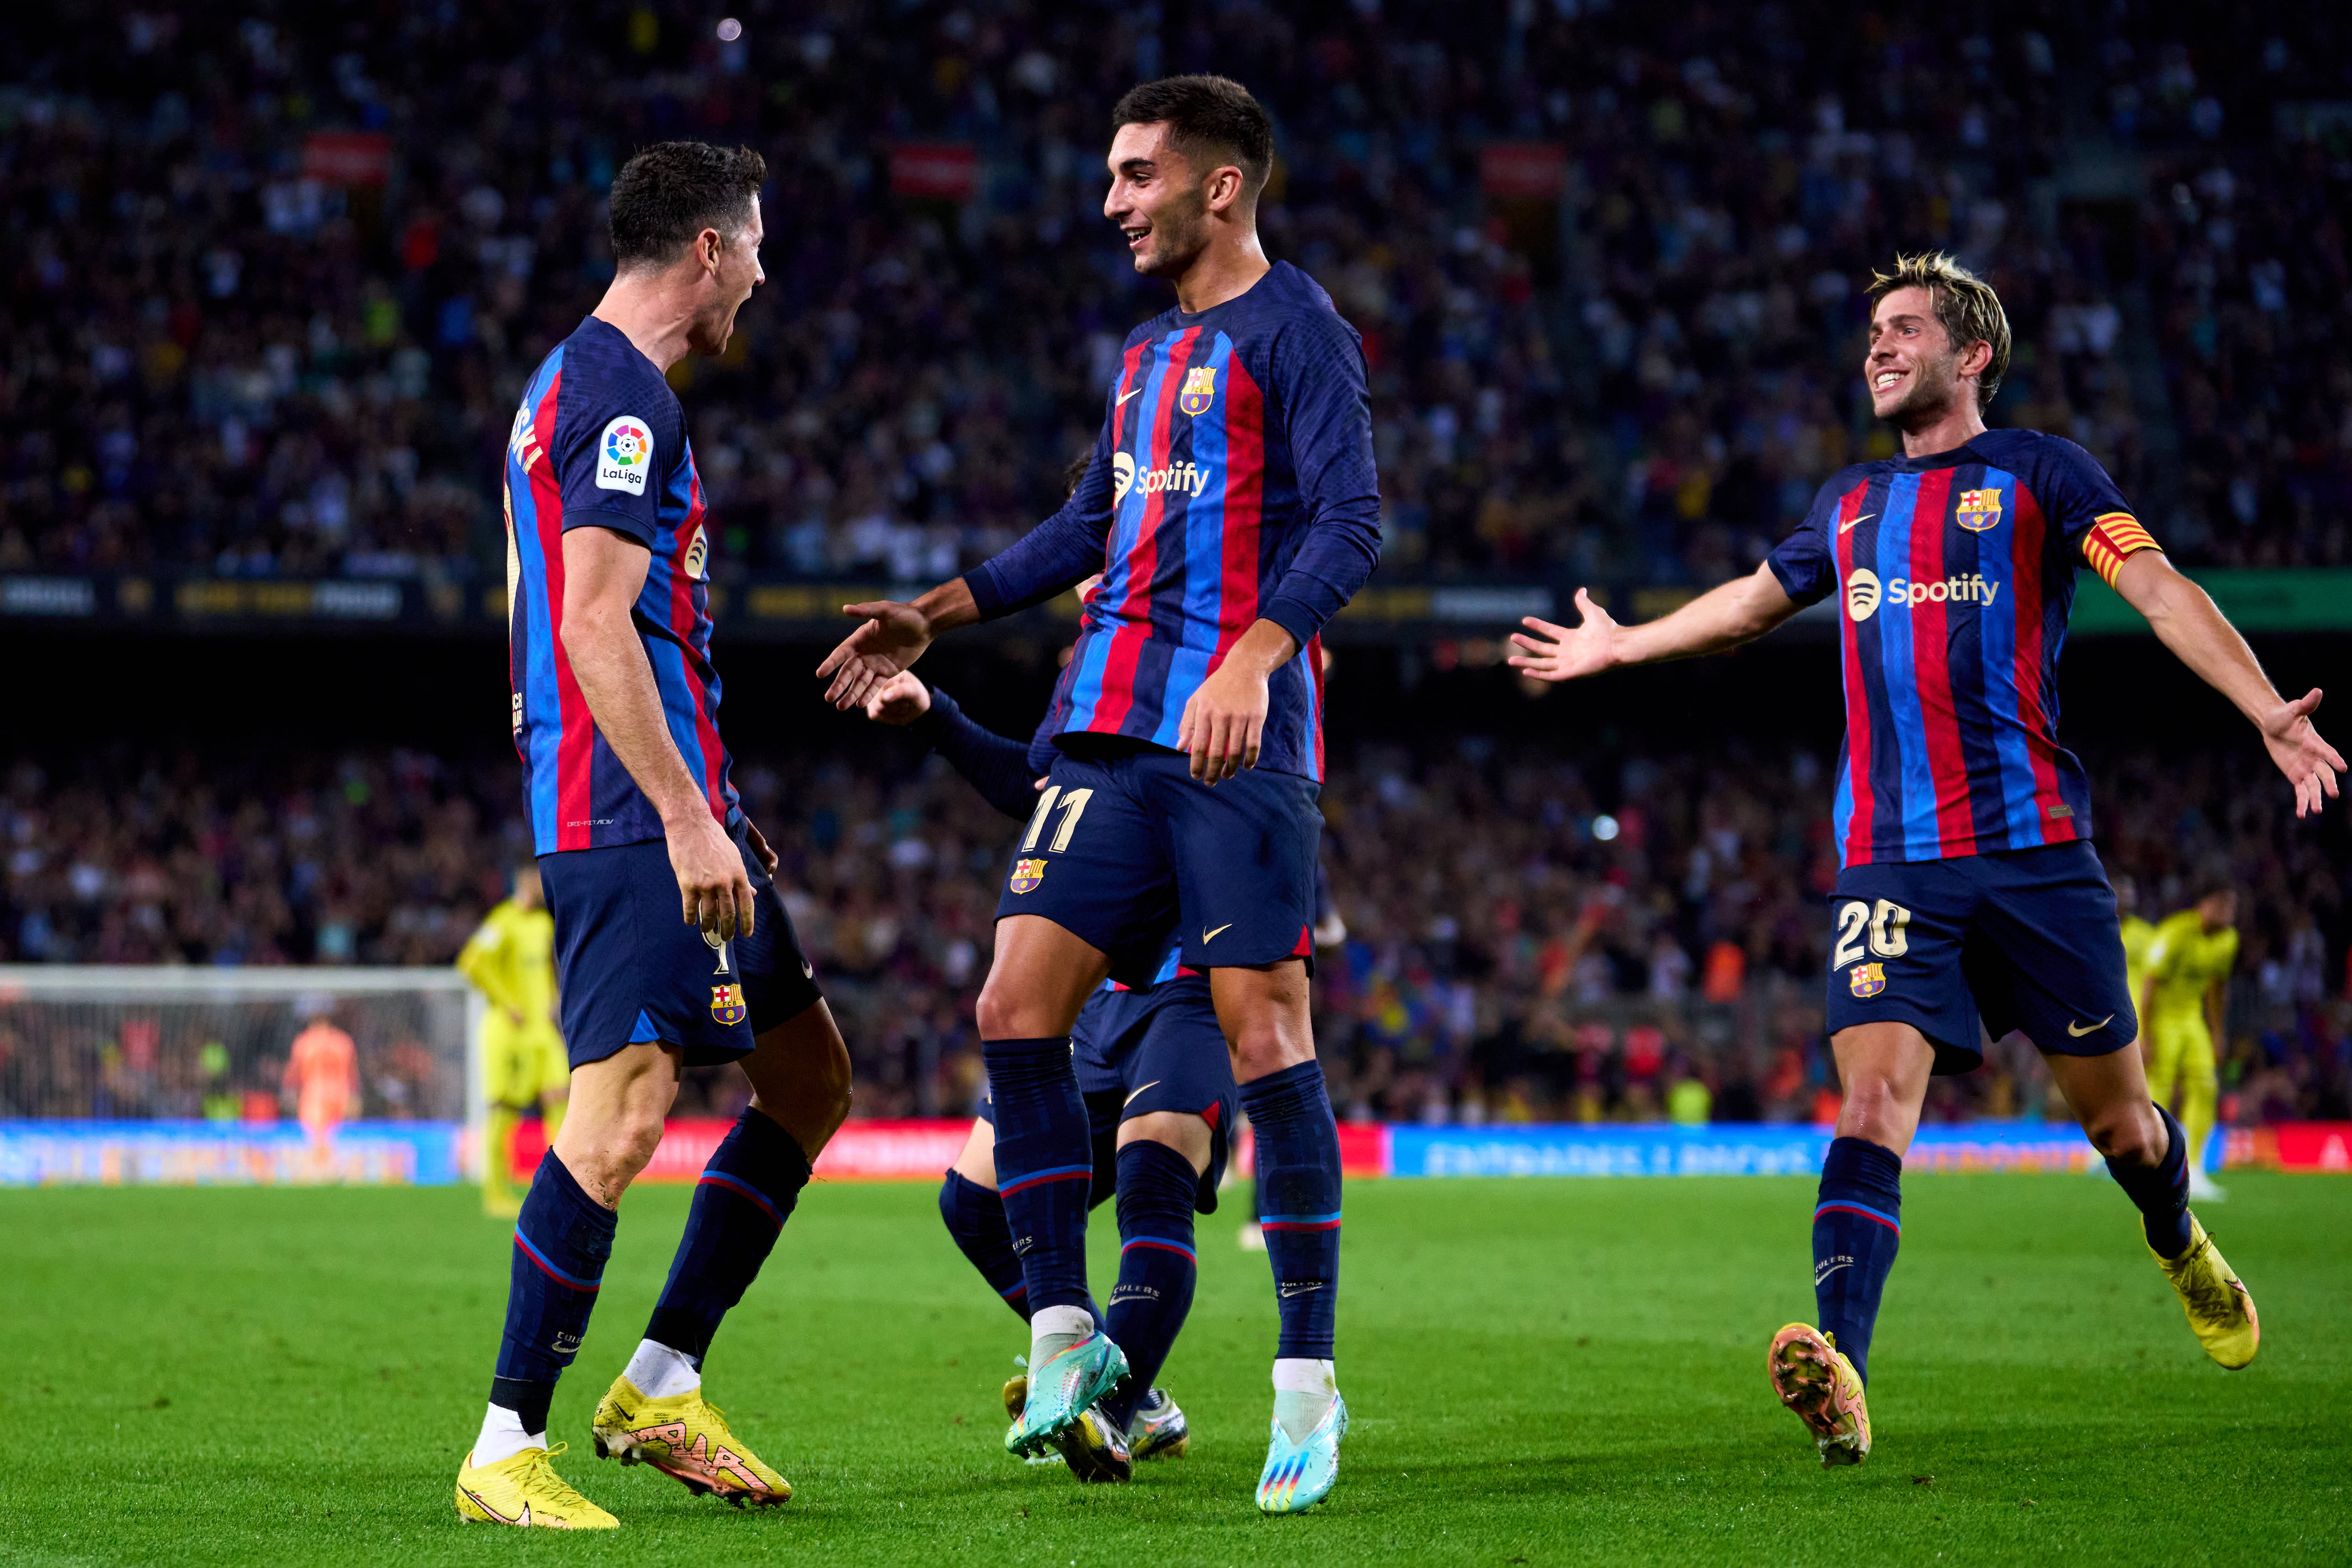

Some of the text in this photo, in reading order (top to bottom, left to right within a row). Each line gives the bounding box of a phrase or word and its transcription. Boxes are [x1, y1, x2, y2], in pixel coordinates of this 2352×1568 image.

[603, 468, 642, 484] LaLiga
[1135, 460, 1209, 499] Spotify
[1888, 573, 2000, 608] Spotify
[1021, 785, 1094, 854] 11
[1834, 899, 1911, 972] 20
[1013, 1236, 1033, 1251] LERS
[1816, 1255, 1854, 1274] CULERS
[1114, 1284, 1160, 1297] CULERS
